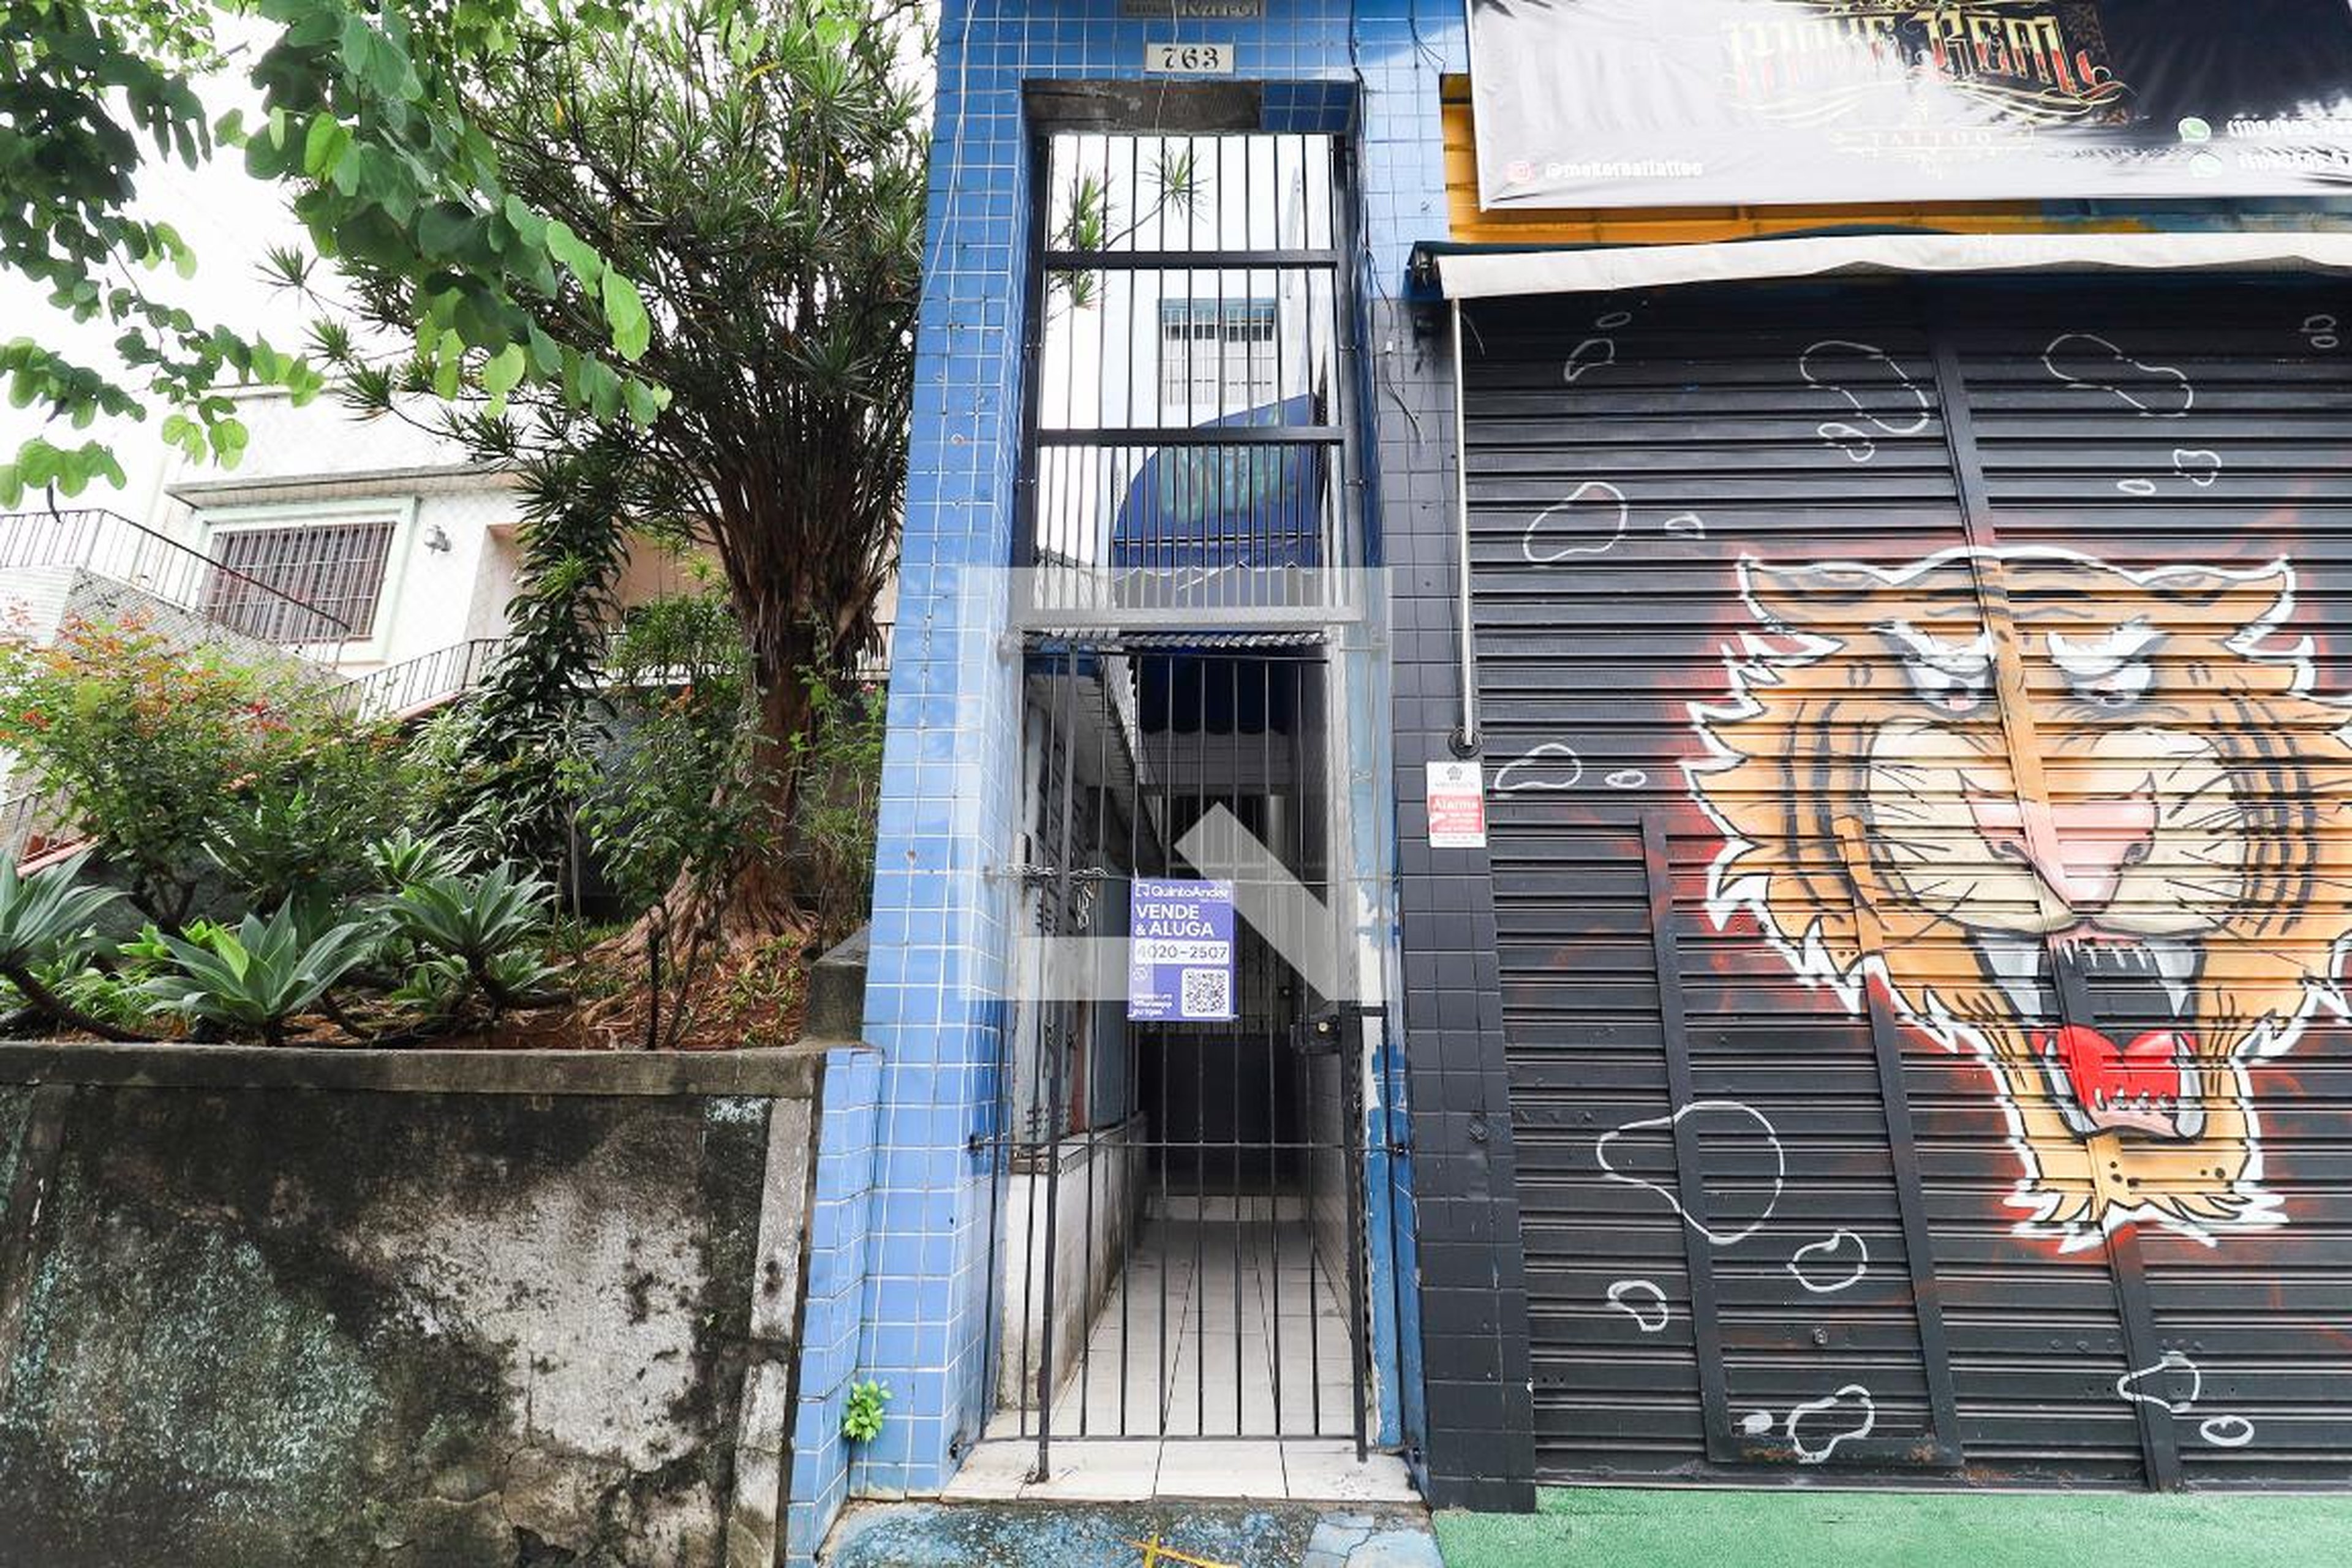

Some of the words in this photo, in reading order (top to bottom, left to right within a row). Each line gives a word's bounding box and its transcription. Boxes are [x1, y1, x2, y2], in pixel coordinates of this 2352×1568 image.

[1163, 47, 1219, 70] 763
[1871, 130, 1991, 146] TATTOO
[1136, 903, 1200, 919] VENDE
[1148, 921, 1215, 937] ALUGA
[1137, 944, 1228, 959] 4020-2507
